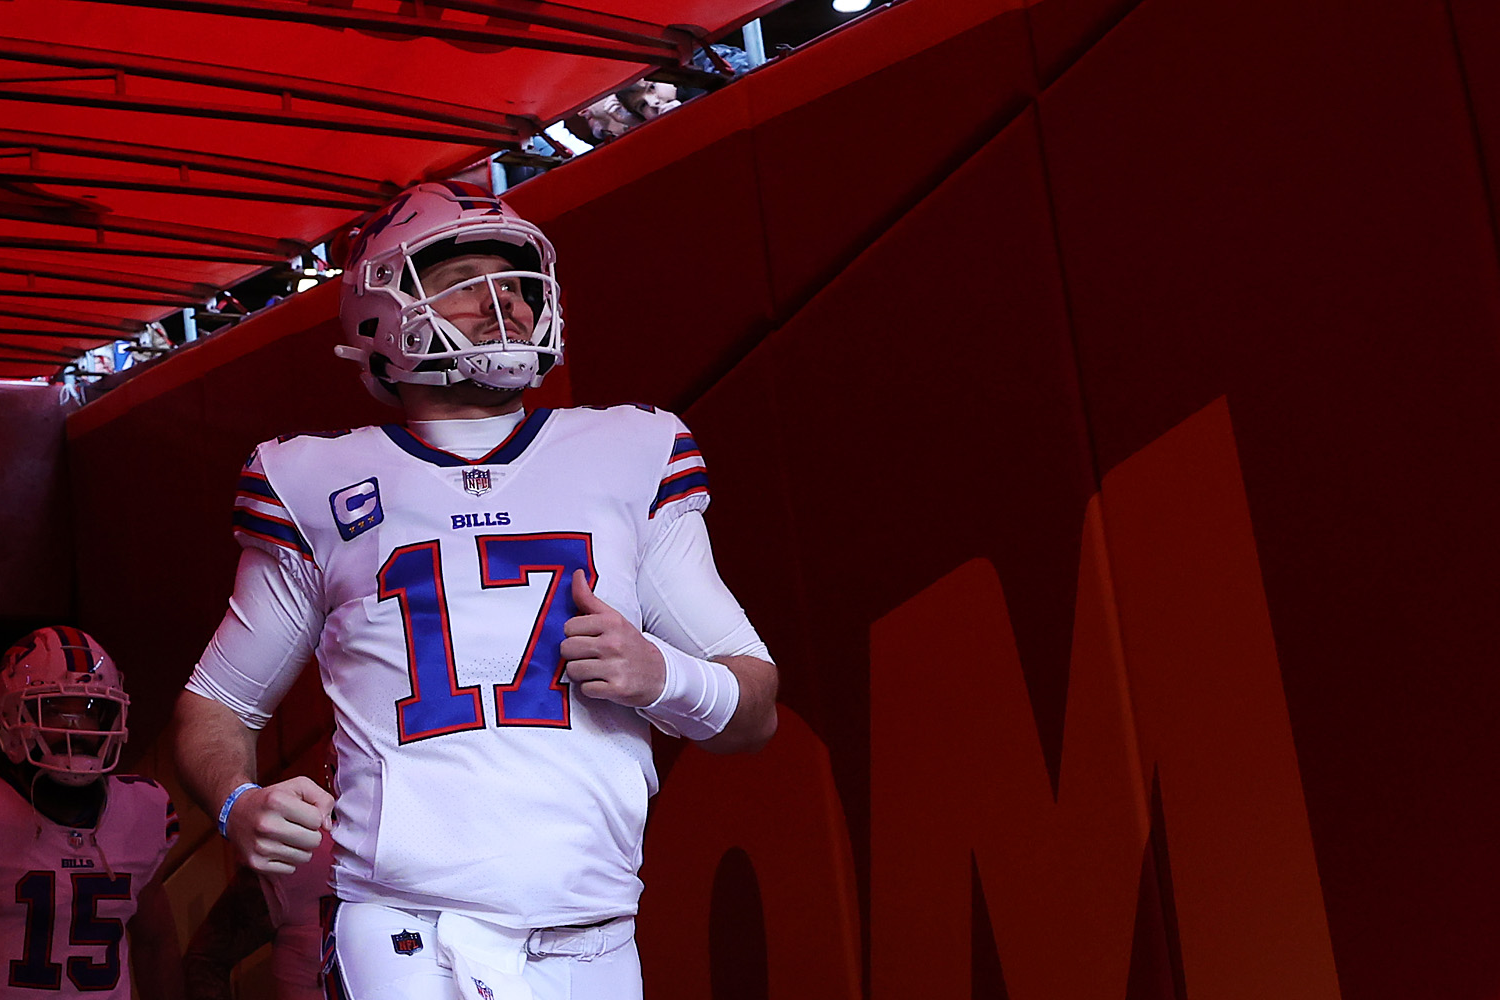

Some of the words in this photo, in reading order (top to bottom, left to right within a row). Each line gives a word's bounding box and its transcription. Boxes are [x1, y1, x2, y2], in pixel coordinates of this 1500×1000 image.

[331, 479, 381, 524] C
[450, 512, 511, 529] BILLS
[377, 531, 599, 746] 17
[61, 858, 95, 868] BILLS
[8, 870, 132, 992] 15
